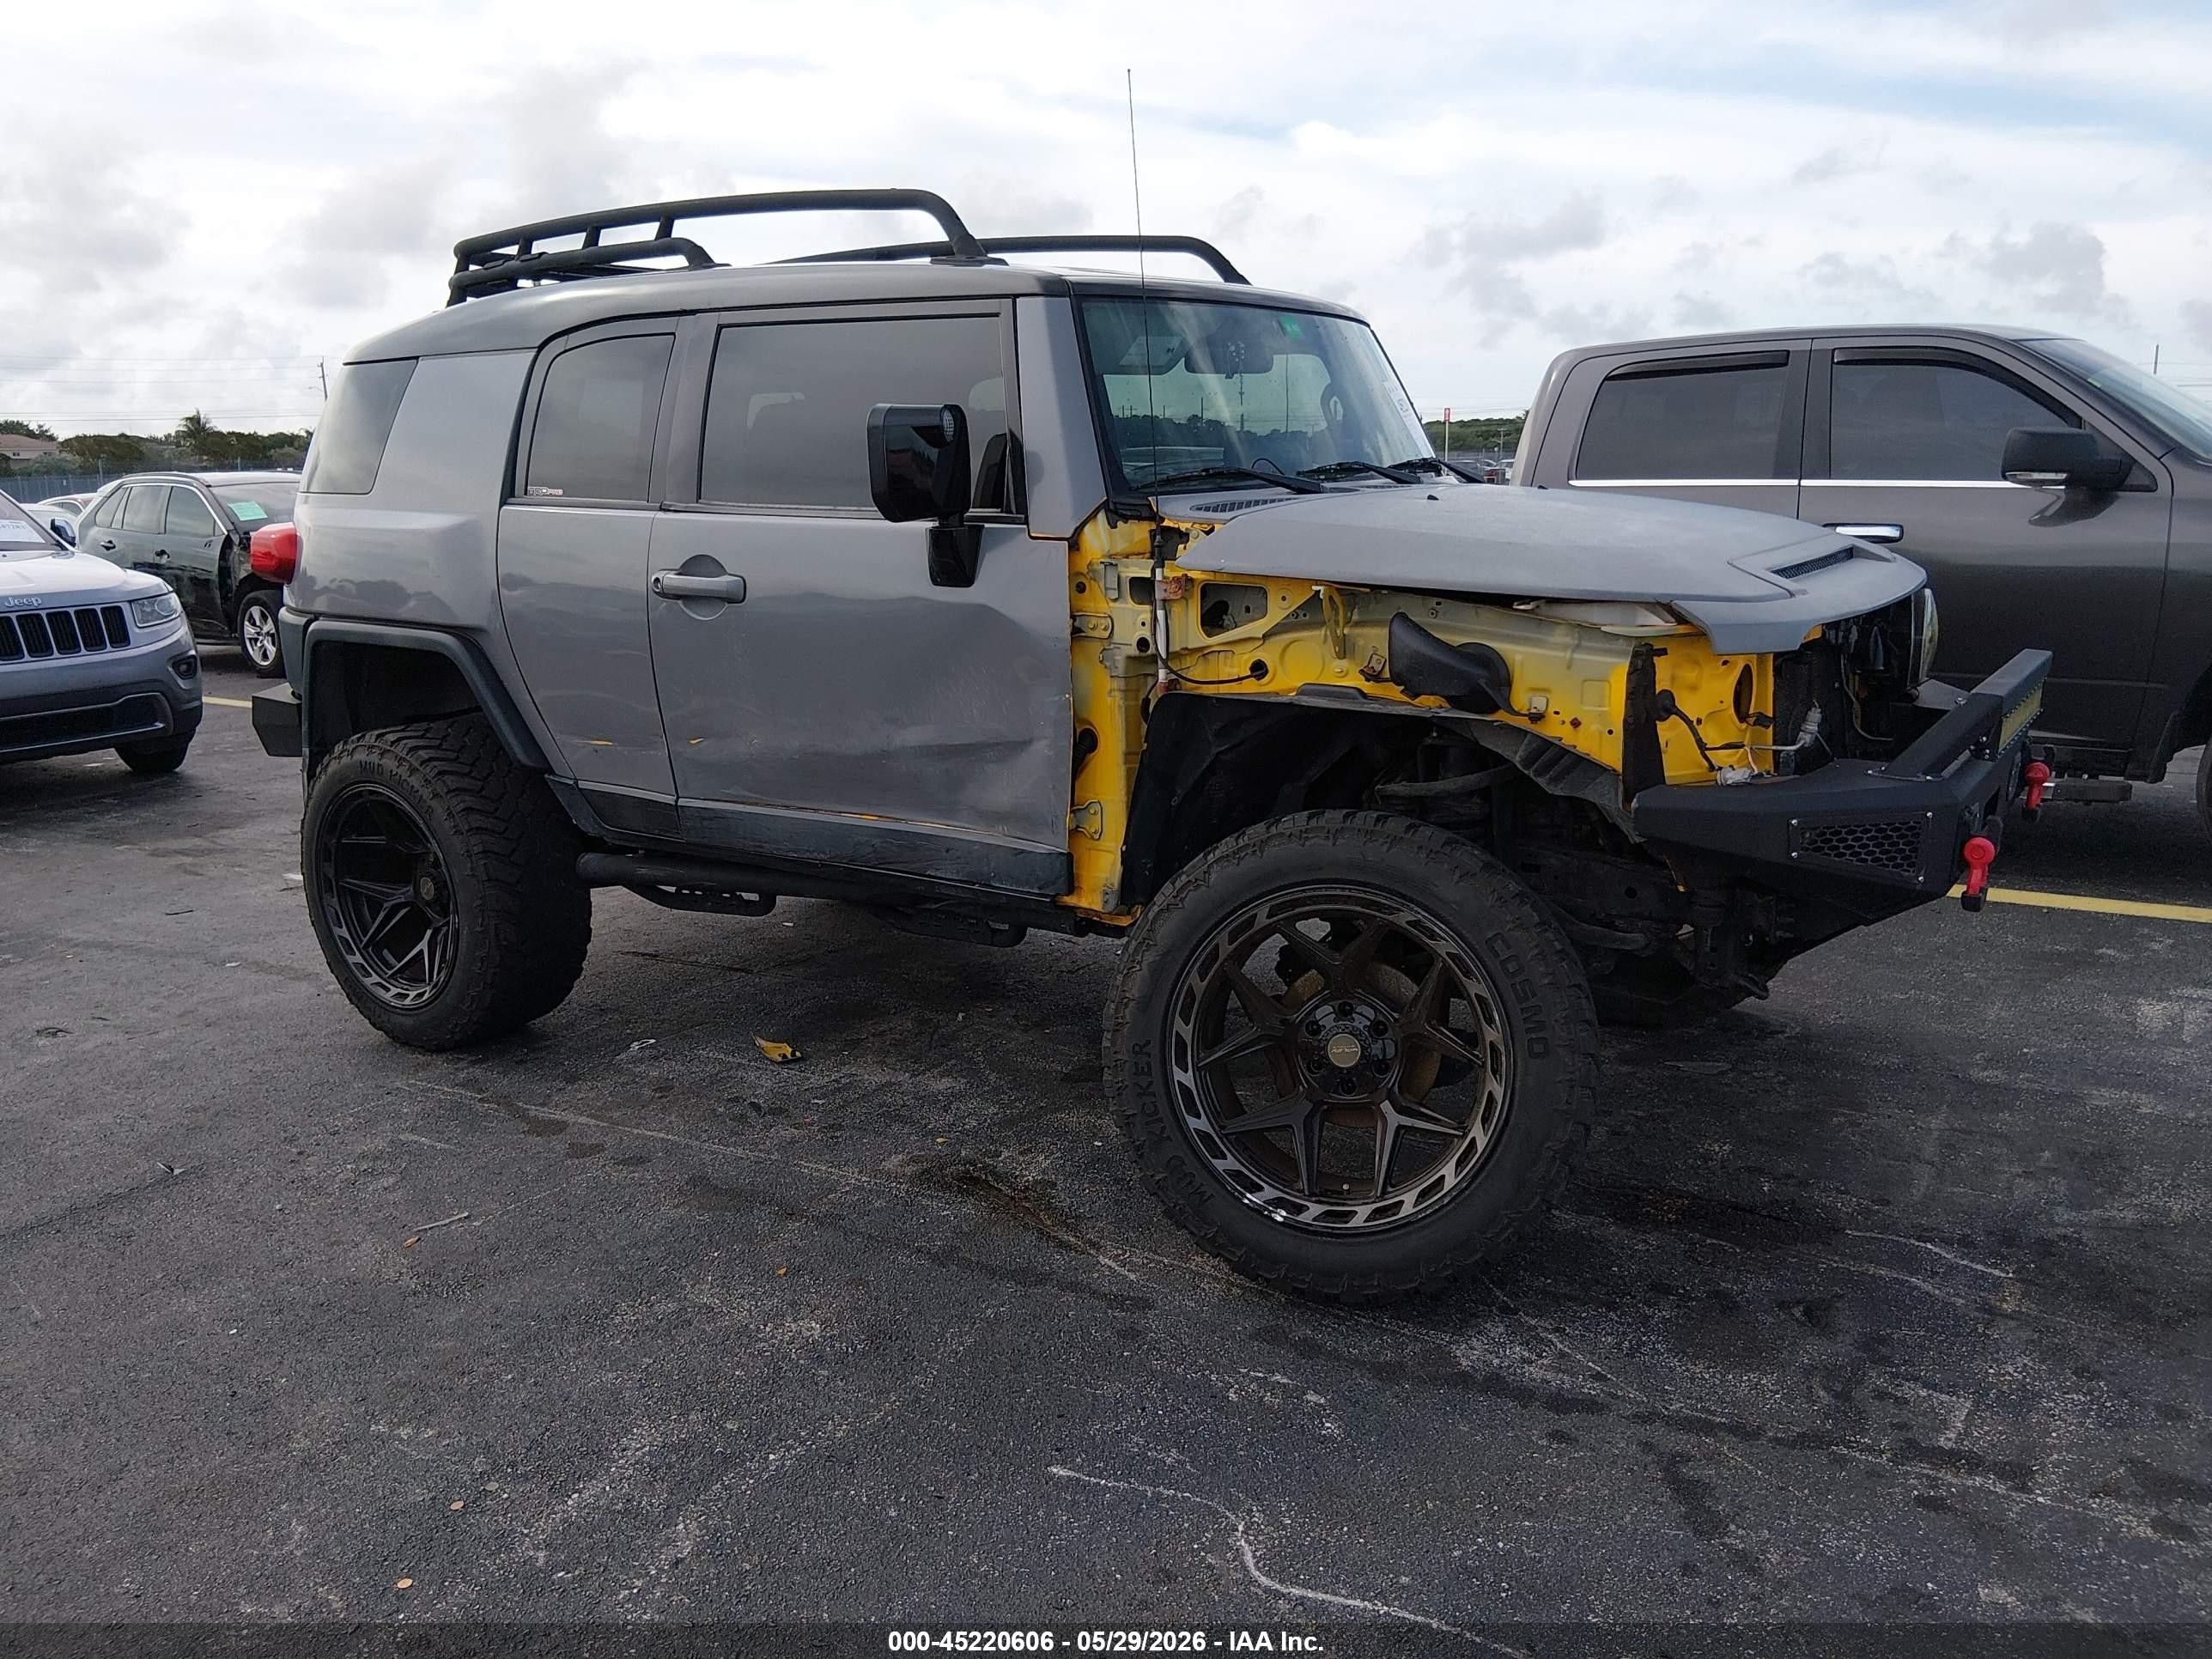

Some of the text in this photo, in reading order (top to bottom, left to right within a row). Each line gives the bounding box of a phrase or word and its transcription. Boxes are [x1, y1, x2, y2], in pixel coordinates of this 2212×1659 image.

[4, 596, 42, 607] Jeep
[1484, 932, 1549, 1060] COSMO
[1133, 1038, 1216, 1205] MUD KICKER
